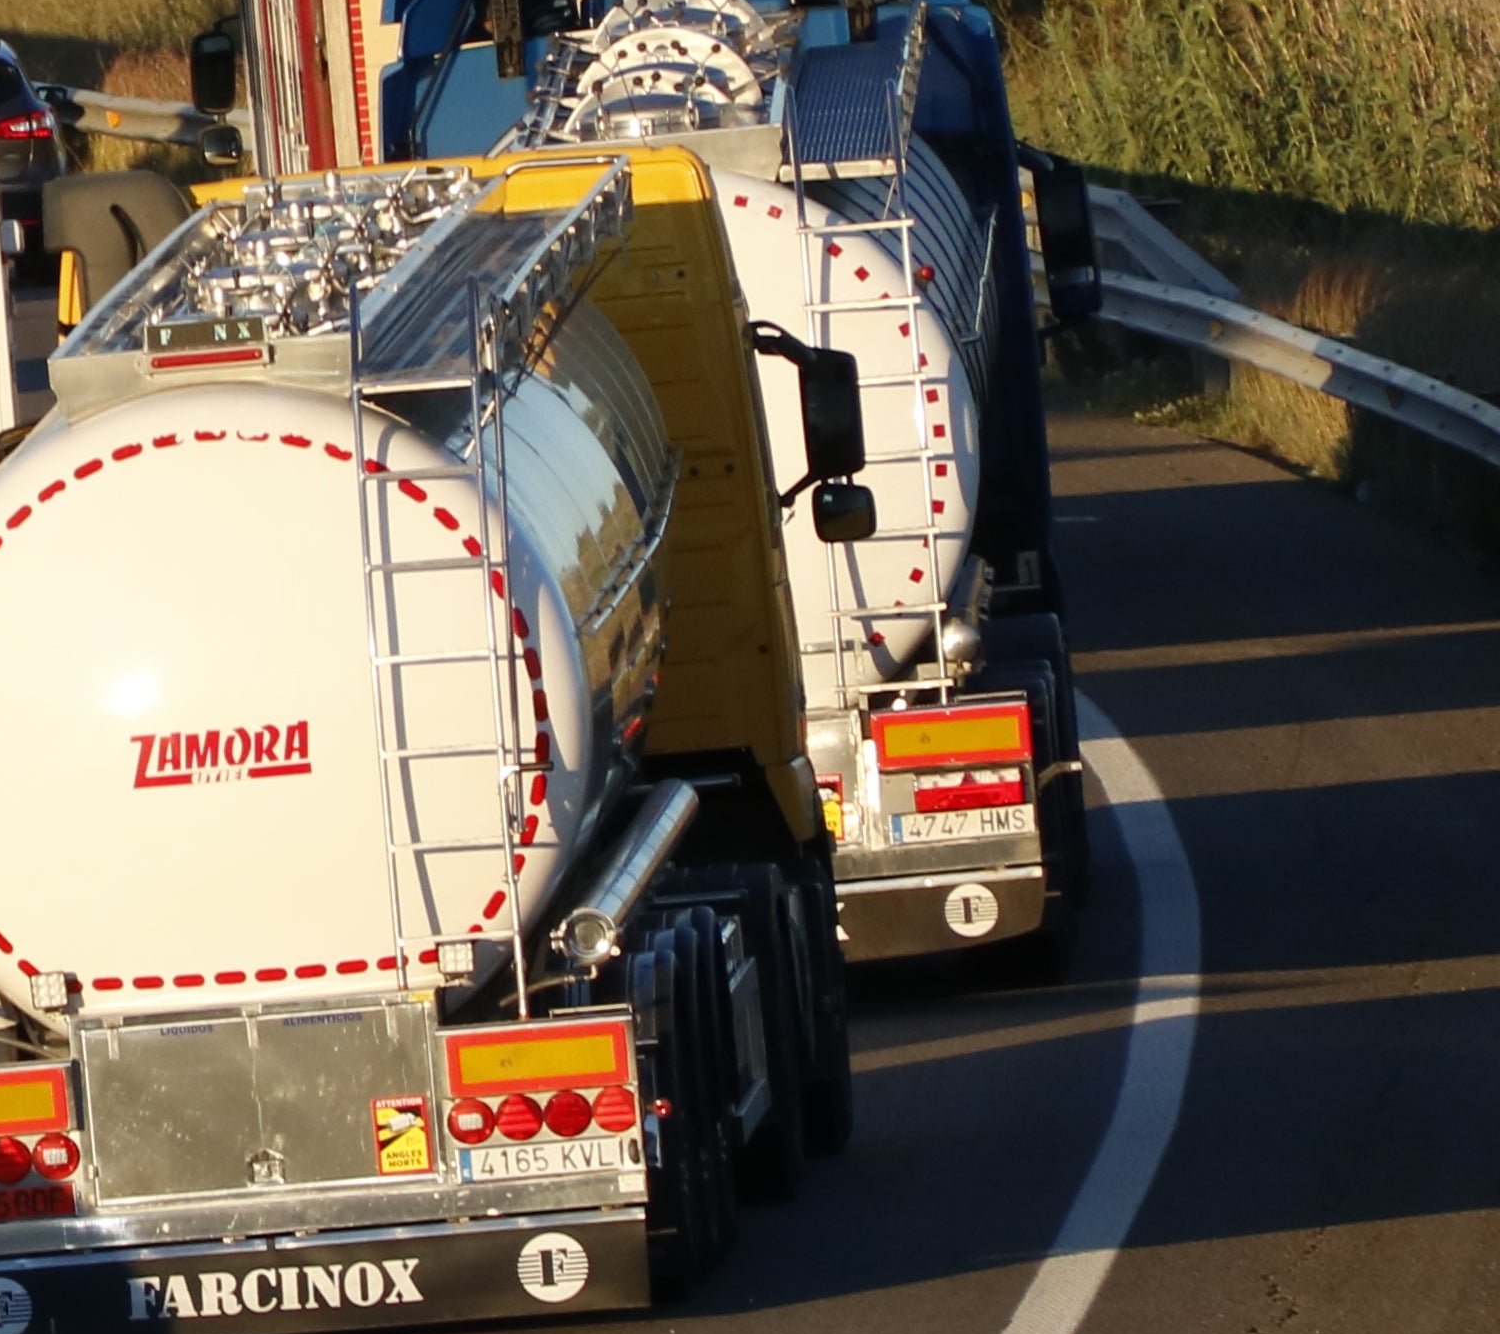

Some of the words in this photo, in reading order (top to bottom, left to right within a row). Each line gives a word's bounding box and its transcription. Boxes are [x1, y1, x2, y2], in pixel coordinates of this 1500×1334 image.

[130, 720, 310, 789] ZAMORA
[909, 813, 968, 838] 4747
[980, 808, 1026, 833] HMS
[159, 1022, 213, 1037] LIQUIDOS
[376, 1096, 423, 1109] ATTENTION
[386, 1149, 423, 1162] ANGLES
[388, 1158, 422, 1170] MORTS
[480, 1146, 549, 1177] 4165
[561, 1140, 614, 1171] KVL
[128, 1259, 425, 1321] FARCINOX
